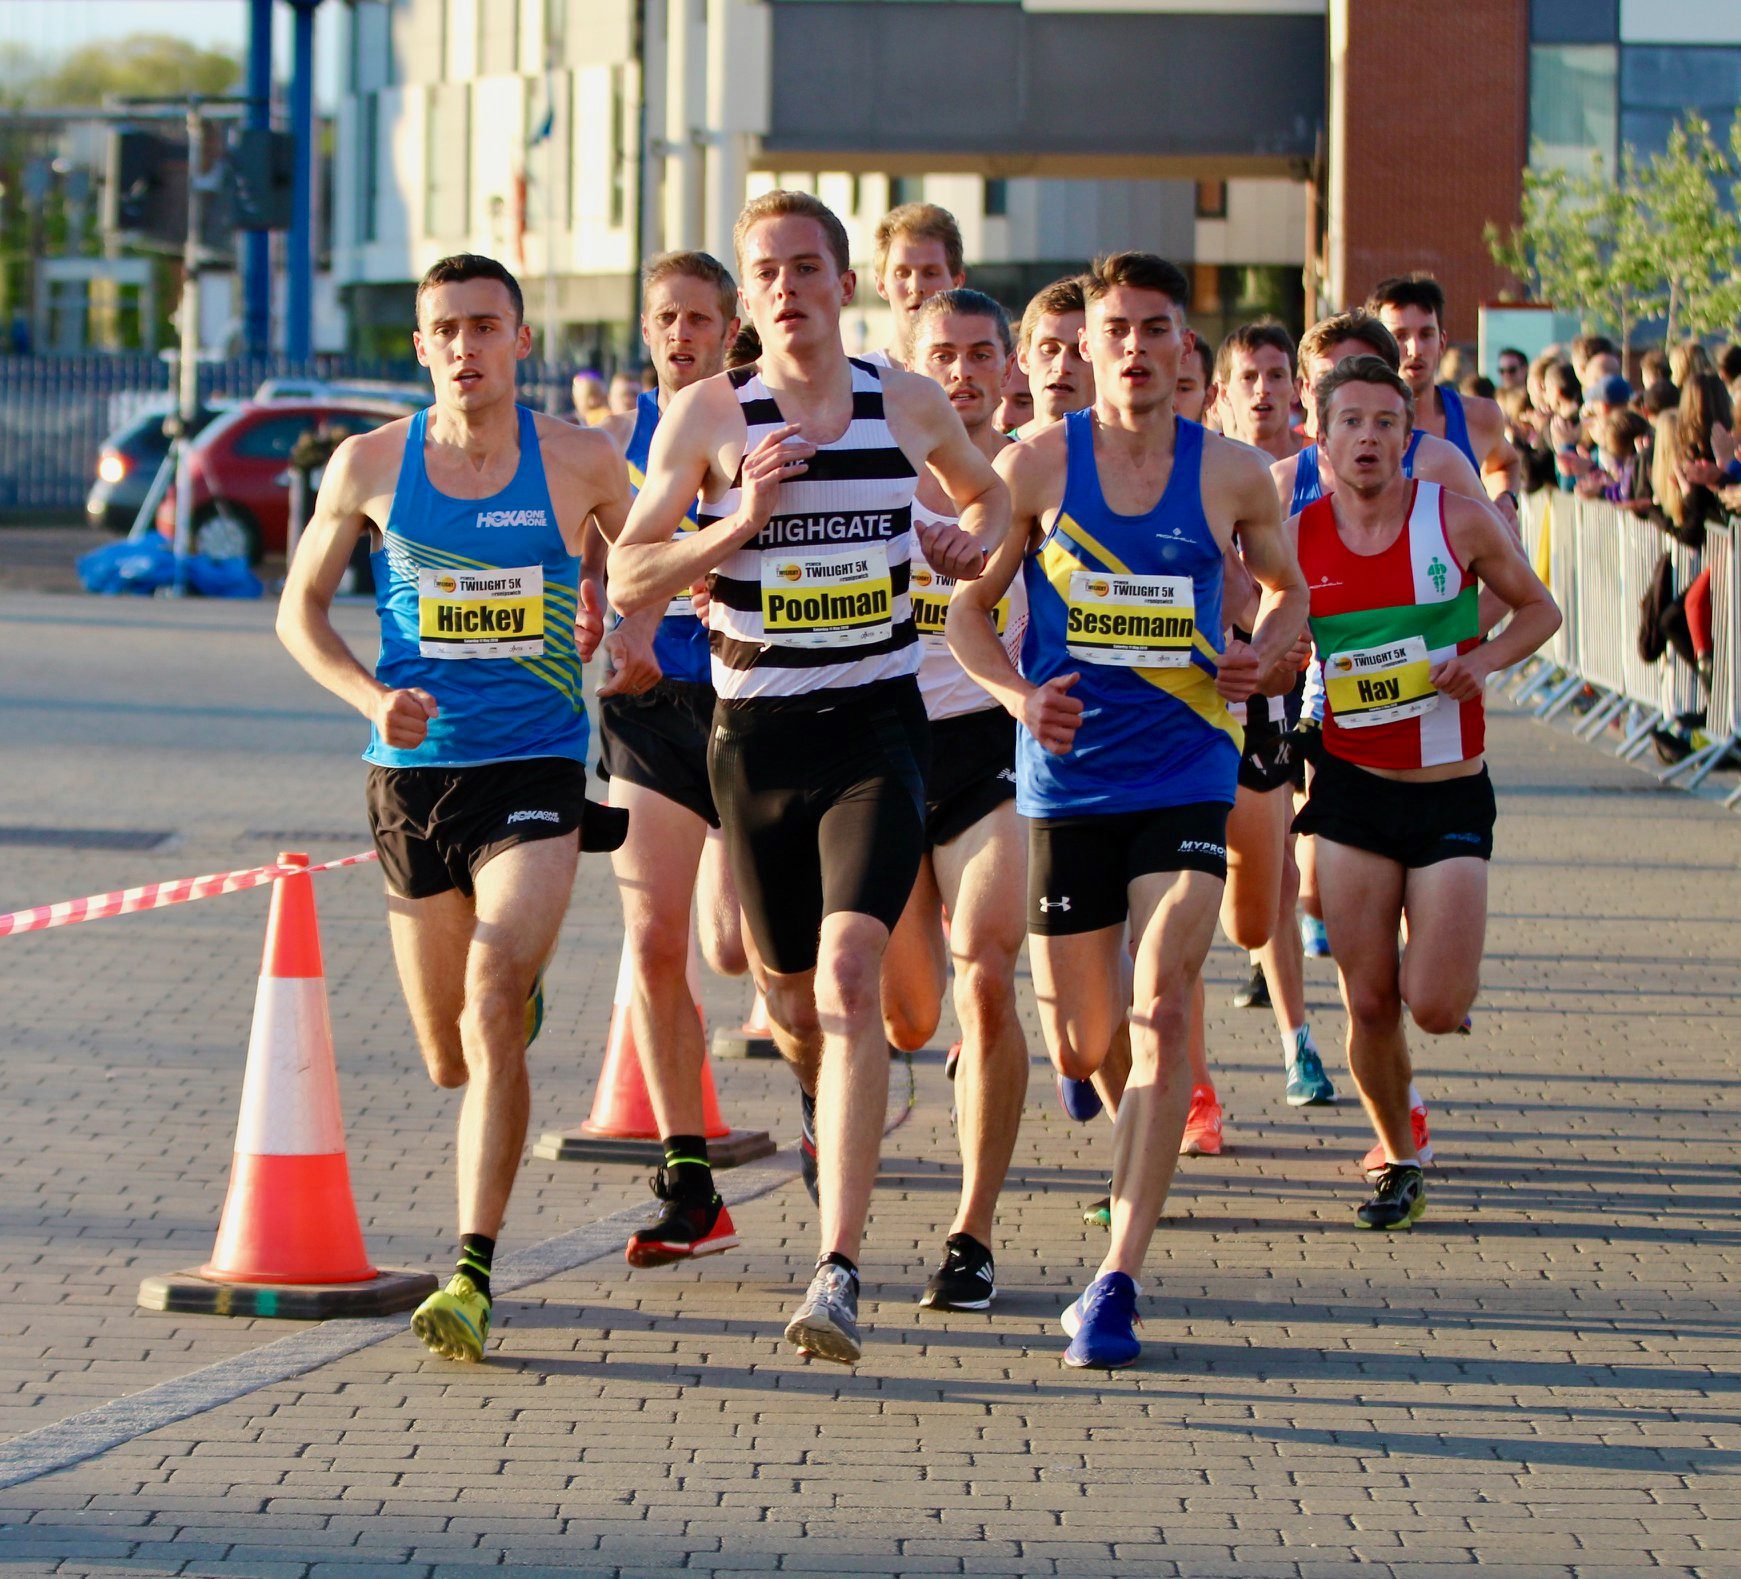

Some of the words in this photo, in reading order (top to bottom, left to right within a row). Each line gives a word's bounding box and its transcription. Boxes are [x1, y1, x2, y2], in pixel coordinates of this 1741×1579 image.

[476, 510, 526, 528] HOKA
[758, 514, 892, 545] HIGHGATE
[805, 562, 854, 578] TWILIGHT
[856, 560, 869, 572] 5K
[460, 579, 507, 592] TWILIGHT
[508, 578, 521, 589] 5K
[1113, 584, 1159, 597] TWILIGHT
[1161, 586, 1174, 598] 5K
[768, 589, 887, 622] Poolman
[437, 605, 526, 633] Hickey
[1068, 606, 1194, 638] Sesemann
[1354, 651, 1393, 667] TWILIGHT
[1394, 647, 1407, 659] 5K
[1357, 677, 1400, 703] Hay
[507, 810, 545, 824] HOKA
